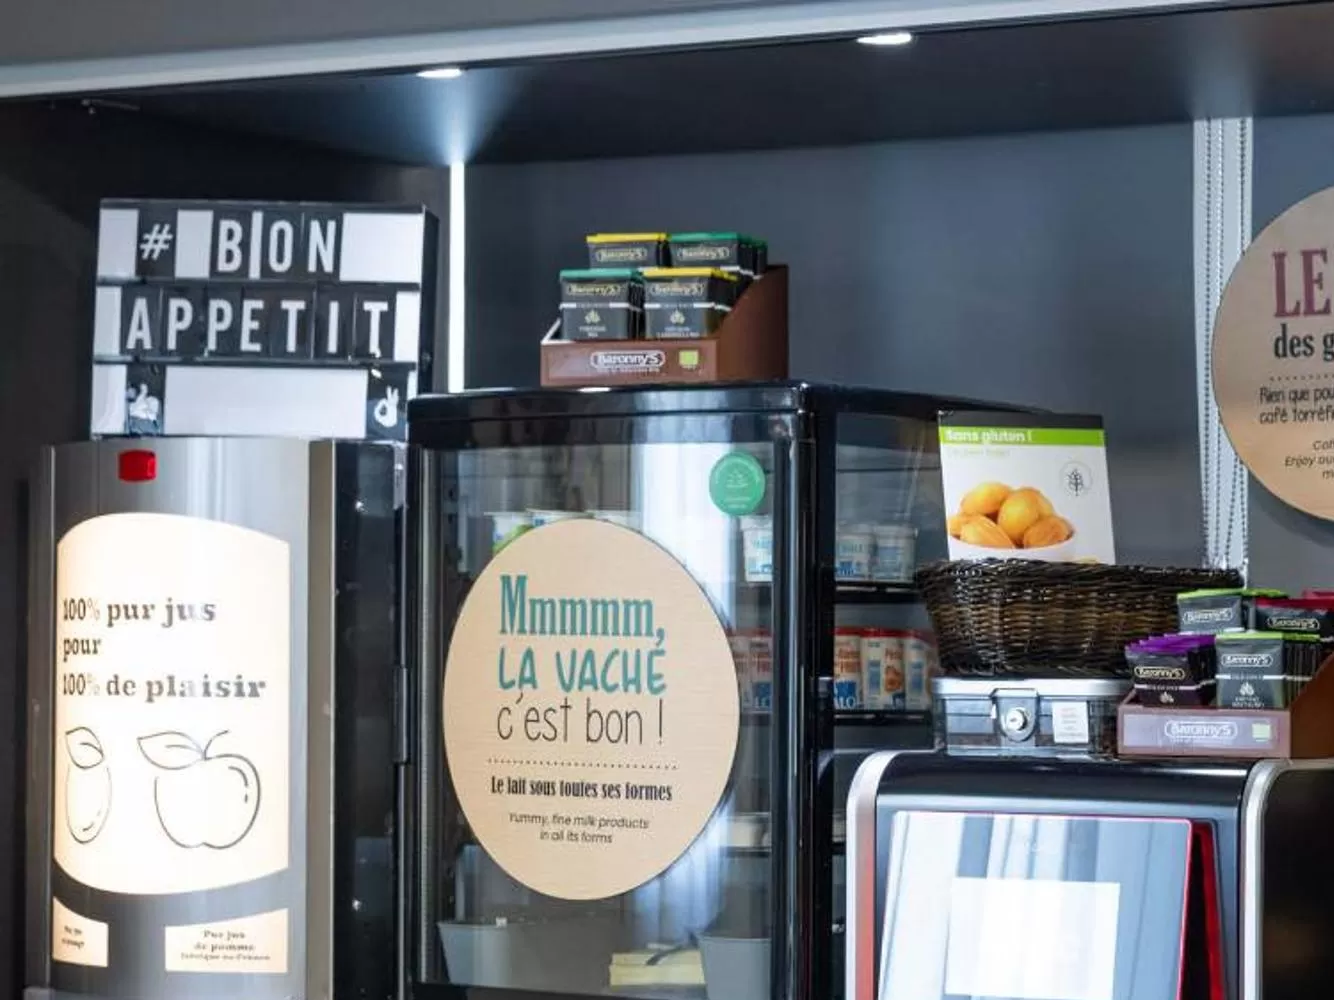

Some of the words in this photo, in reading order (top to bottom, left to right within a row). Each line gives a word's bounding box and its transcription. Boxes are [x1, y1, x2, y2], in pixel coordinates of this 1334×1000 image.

[140, 224, 173, 260] #
[1272, 248, 1331, 318] LE
[126, 297, 389, 353] APPETIT
[1273, 323, 1314, 359] des
[1259, 386, 1285, 404] Rien
[1288, 388, 1310, 404] que
[1259, 407, 1288, 425] café
[1284, 455, 1316, 468] Enjoy
[107, 602, 154, 628] pur
[161, 598, 216, 628] jus
[499, 575, 665, 646] Mmmmm,
[63, 637, 101, 662] pour
[499, 646, 538, 690] LA
[555, 647, 667, 695] VACHE
[106, 674, 137, 696] de
[145, 674, 266, 703] plaisir
[497, 692, 572, 742] c'est
[586, 697, 643, 744] bon
[491, 776, 504, 794] Le
[507, 776, 526, 795] lait
[529, 780, 556, 796] sous
[559, 780, 599, 798] toutes
[601, 783, 622, 799] ses
[625, 782, 673, 801] formes
[573, 815, 596, 827] milk
[598, 816, 650, 830] products
[540, 831, 549, 841] in
[551, 831, 565, 841] all
[567, 832, 579, 842] its
[581, 831, 613, 844] forms
